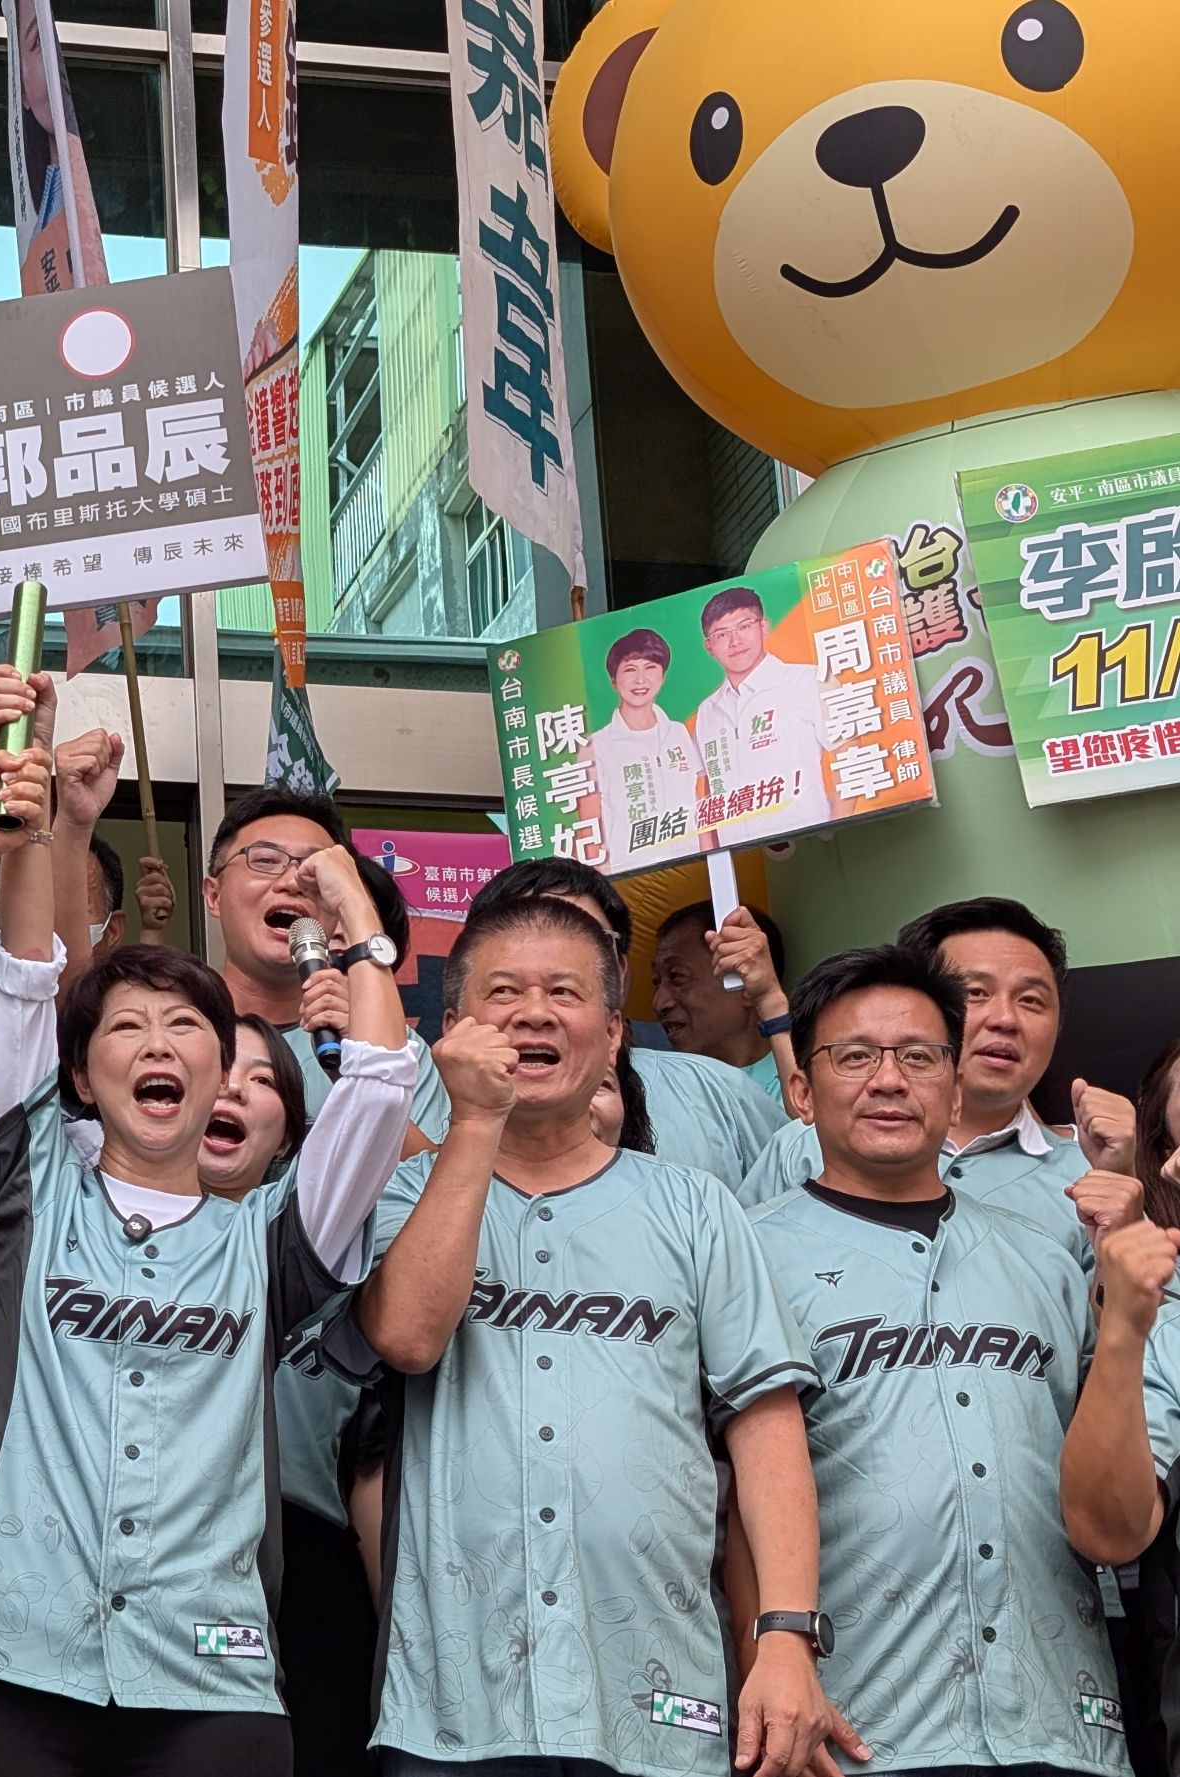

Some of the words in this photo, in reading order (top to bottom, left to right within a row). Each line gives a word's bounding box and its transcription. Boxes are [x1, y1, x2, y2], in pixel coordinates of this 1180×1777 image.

[65, 371, 225, 412] 市議員候選人
[132, 533, 245, 566] 傳辰未來
[814, 574, 833, 608] 北區
[838, 564, 860, 615] 中西區
[868, 585, 915, 725] 台南市議員
[892, 739, 921, 784] 律師
[814, 620, 895, 801] 周嘉韋
[500, 676, 545, 862] 台南市長候選
[535, 703, 609, 869] 陳亭妃
[629, 806, 689, 853] 團結
[424, 865, 503, 883] 臺南市第
[426, 887, 474, 903] 候選人
[465, 1267, 680, 1347] AINAN
[810, 1313, 1057, 1390] TAINAN
